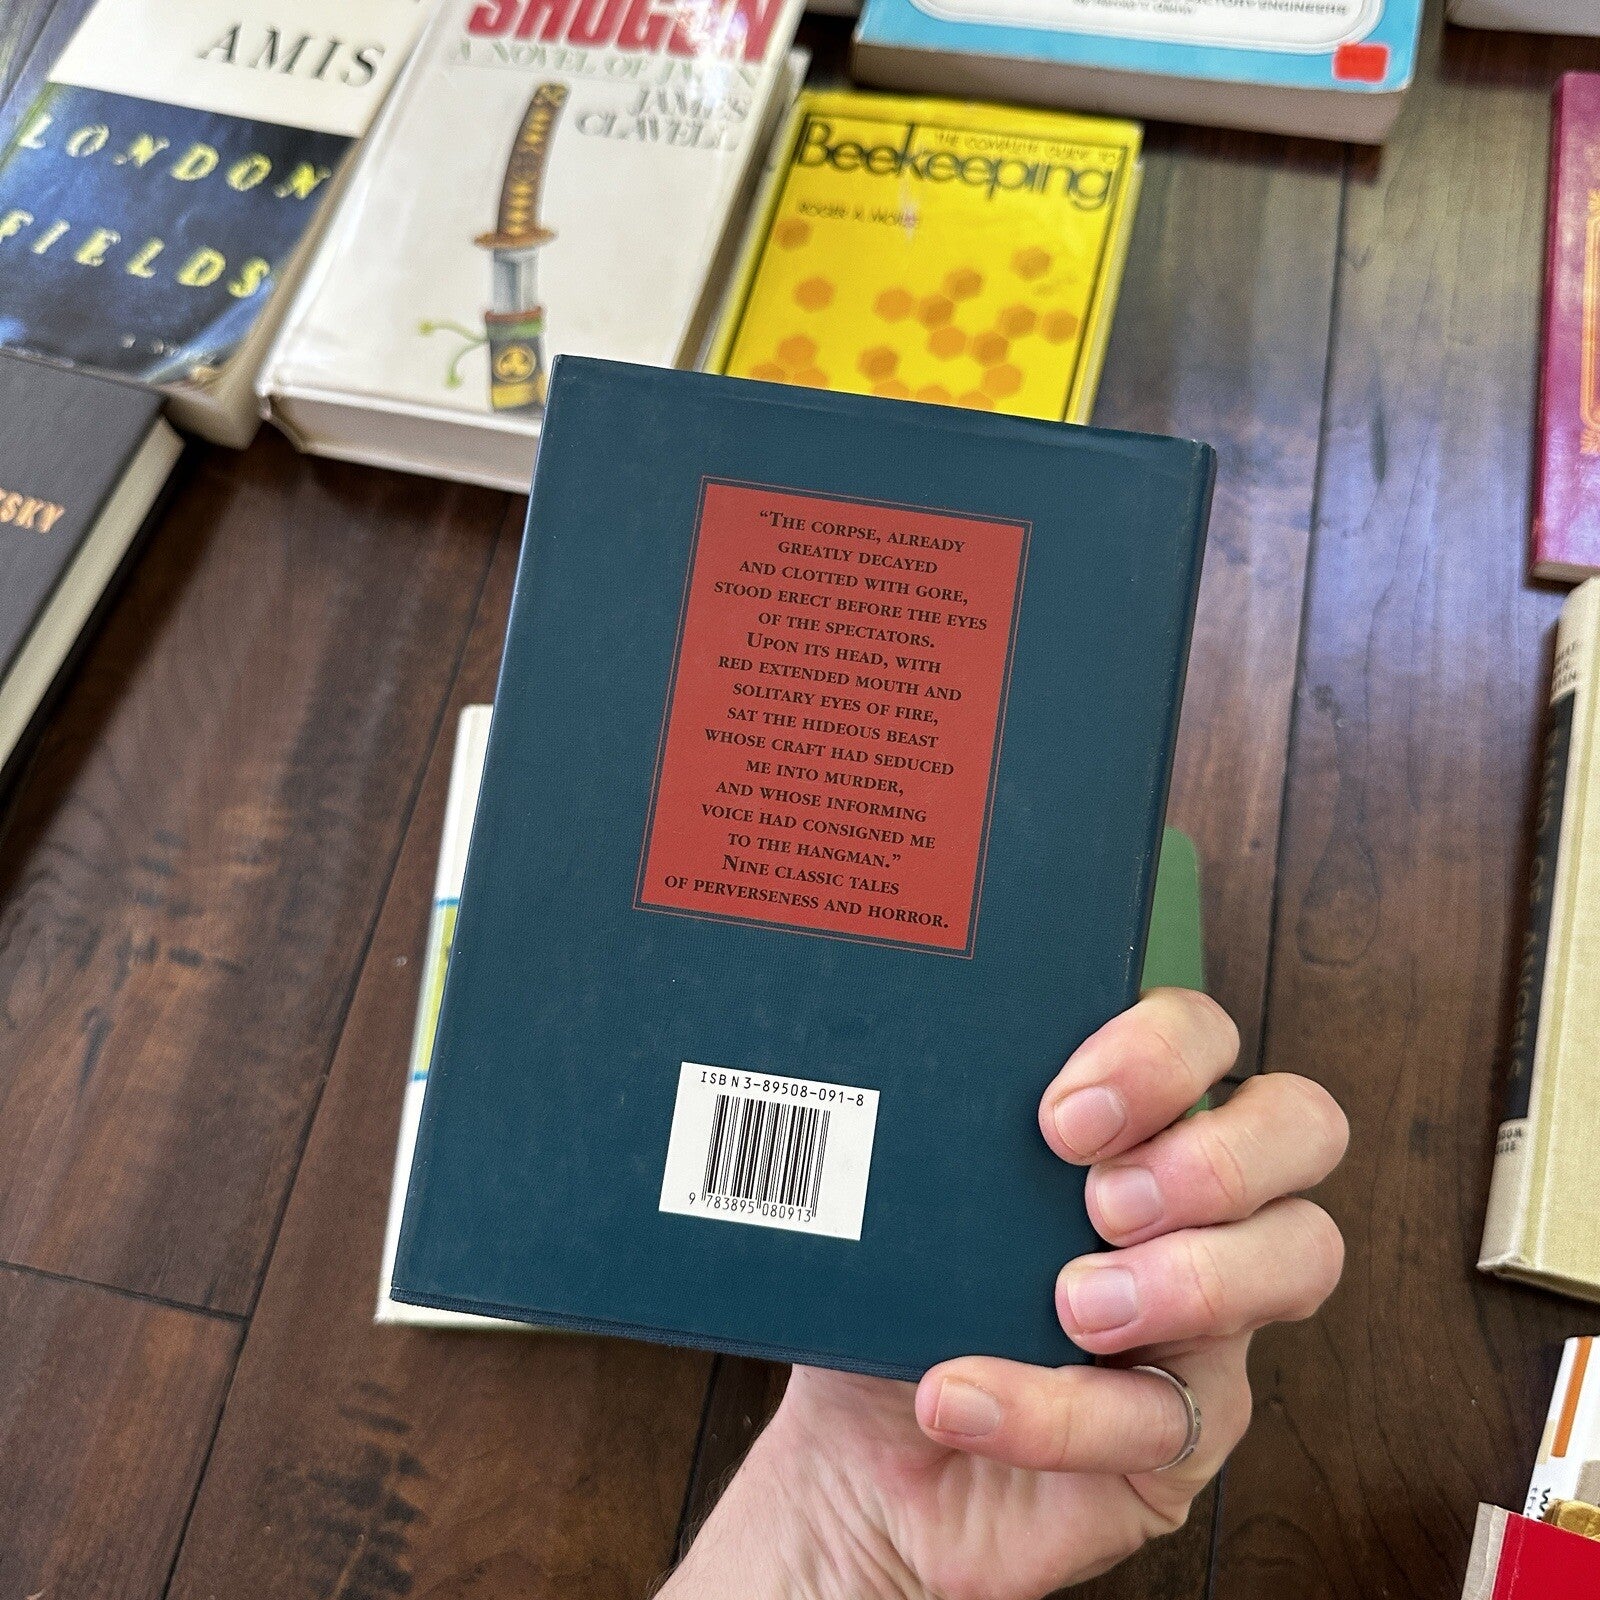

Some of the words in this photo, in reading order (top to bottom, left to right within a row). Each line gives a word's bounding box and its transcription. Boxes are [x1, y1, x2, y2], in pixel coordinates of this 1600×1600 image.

[197, 22, 386, 88] AMIS
[481, 42, 597, 74] NOVEL
[604, 54, 648, 78] OF
[17, 113, 332, 200] LONDON
[797, 120, 1114, 211] Beekeeping
[0, 209, 271, 299] FIELDS
[0, 487, 65, 534] SKY
[760, 511, 805, 530] “THE
[811, 522, 880, 543] CORPSE,
[887, 533, 965, 552] ALREADY
[778, 542, 852, 562] GREATLY
[858, 553, 937, 573] DECAYED
[740, 561, 776, 575] AND
[782, 567, 858, 587] CLOTTED
[865, 578, 909, 594] WITH
[916, 586, 967, 605] GORE,
[714, 582, 771, 599] STOOD
[778, 590, 831, 607] ERECT
[837, 599, 902, 618] BEFORE
[908, 609, 941, 624] THE
[947, 614, 986, 630] EYES
[759, 613, 781, 625] OF
[787, 616, 820, 630] THE
[826, 622, 934, 647] SPECTATORS.
[748, 632, 797, 652] UPON
[805, 644, 829, 657] ITS
[835, 648, 888, 669] HEAD,
[896, 657, 941, 673] WITH
[718, 656, 752, 670] RED
[759, 662, 849, 684] EXTENDED
[856, 676, 919, 695] MOUTH
[924, 686, 961, 700] AND
[733, 683, 814, 705] SOLITARY
[820, 696, 860, 711] EYES
[867, 703, 889, 715] OF
[895, 707, 938, 726] FIRE,
[728, 708, 758, 721] SAT
[763, 712, 795, 727] THE
[803, 718, 880, 739] HIDEOUS
[887, 730, 938, 747] BEAST
[705, 729, 765, 748] WHOSE
[772, 740, 826, 756] CRAFT
[831, 748, 868, 762] HAD
[875, 754, 953, 775] SEDUCED
[746, 760, 770, 774] ME
[777, 765, 818, 780] INTO
[825, 771, 903, 796] MURDER,
[716, 782, 753, 796] AND
[760, 787, 821, 806] WHOSE
[827, 797, 926, 822] INFORMING
[702, 804, 753, 821] VOICE
[759, 813, 796, 828] HAD
[803, 819, 904, 843] CONSIGNED
[910, 835, 935, 848] ME
[729, 833, 751, 847] TO
[757, 838, 791, 853] THE
[797, 844, 900, 868] HANGMAN.”
[722, 855, 767, 875] NINE
[775, 867, 843, 886] CLASSIC
[850, 877, 899, 894] TALES
[665, 876, 688, 889] OF
[694, 880, 819, 908] PERVERSENESS
[826, 900, 861, 914] AND
[868, 905, 948, 928] HORROR.
[701, 1071, 739, 1088] ISBN
[743, 1077, 864, 1107] 3-89508-091-8
[688, 1192, 696, 1205] 9
[706, 1194, 755, 1214] 783895
[762, 1205, 811, 1223] 080913
